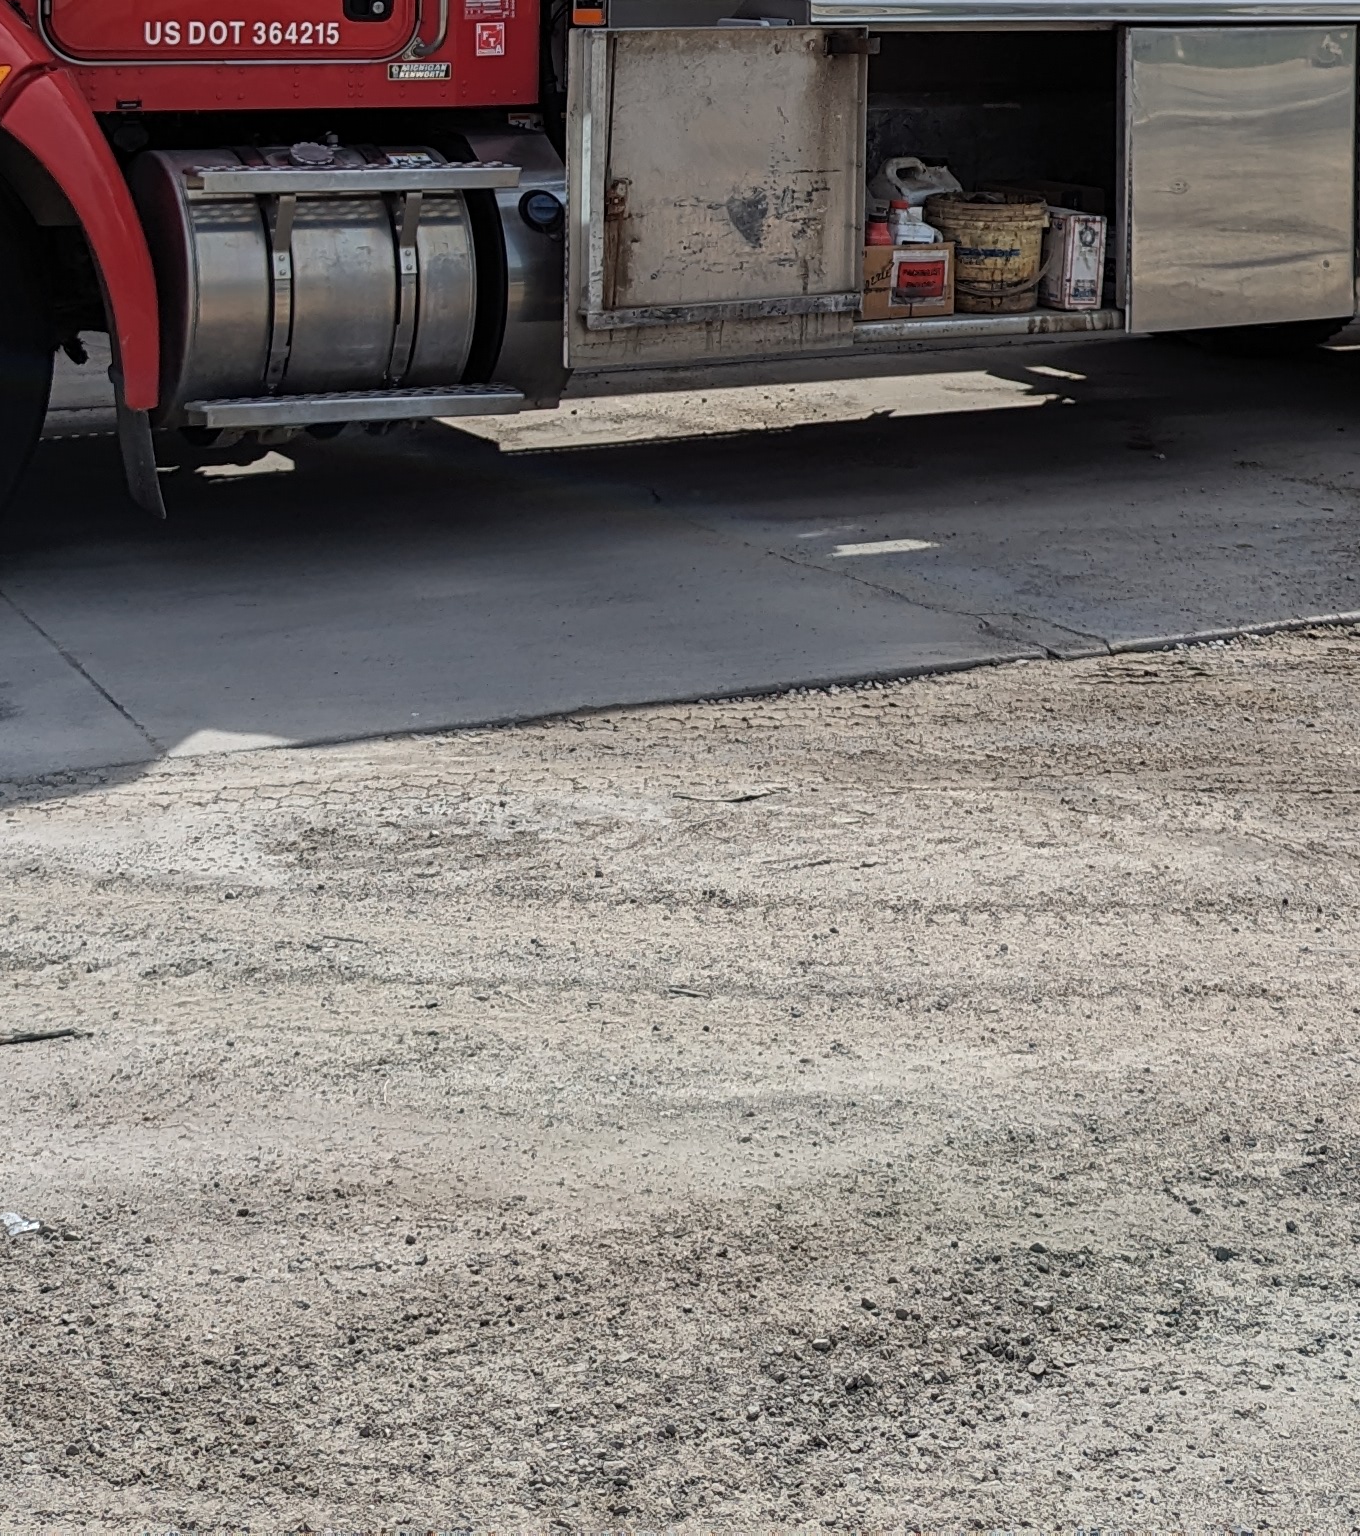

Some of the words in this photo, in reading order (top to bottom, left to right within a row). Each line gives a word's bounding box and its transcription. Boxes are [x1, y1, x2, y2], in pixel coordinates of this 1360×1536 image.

[144, 21, 181, 45] US
[188, 21, 245, 45] DOT
[252, 22, 340, 45] 364215
